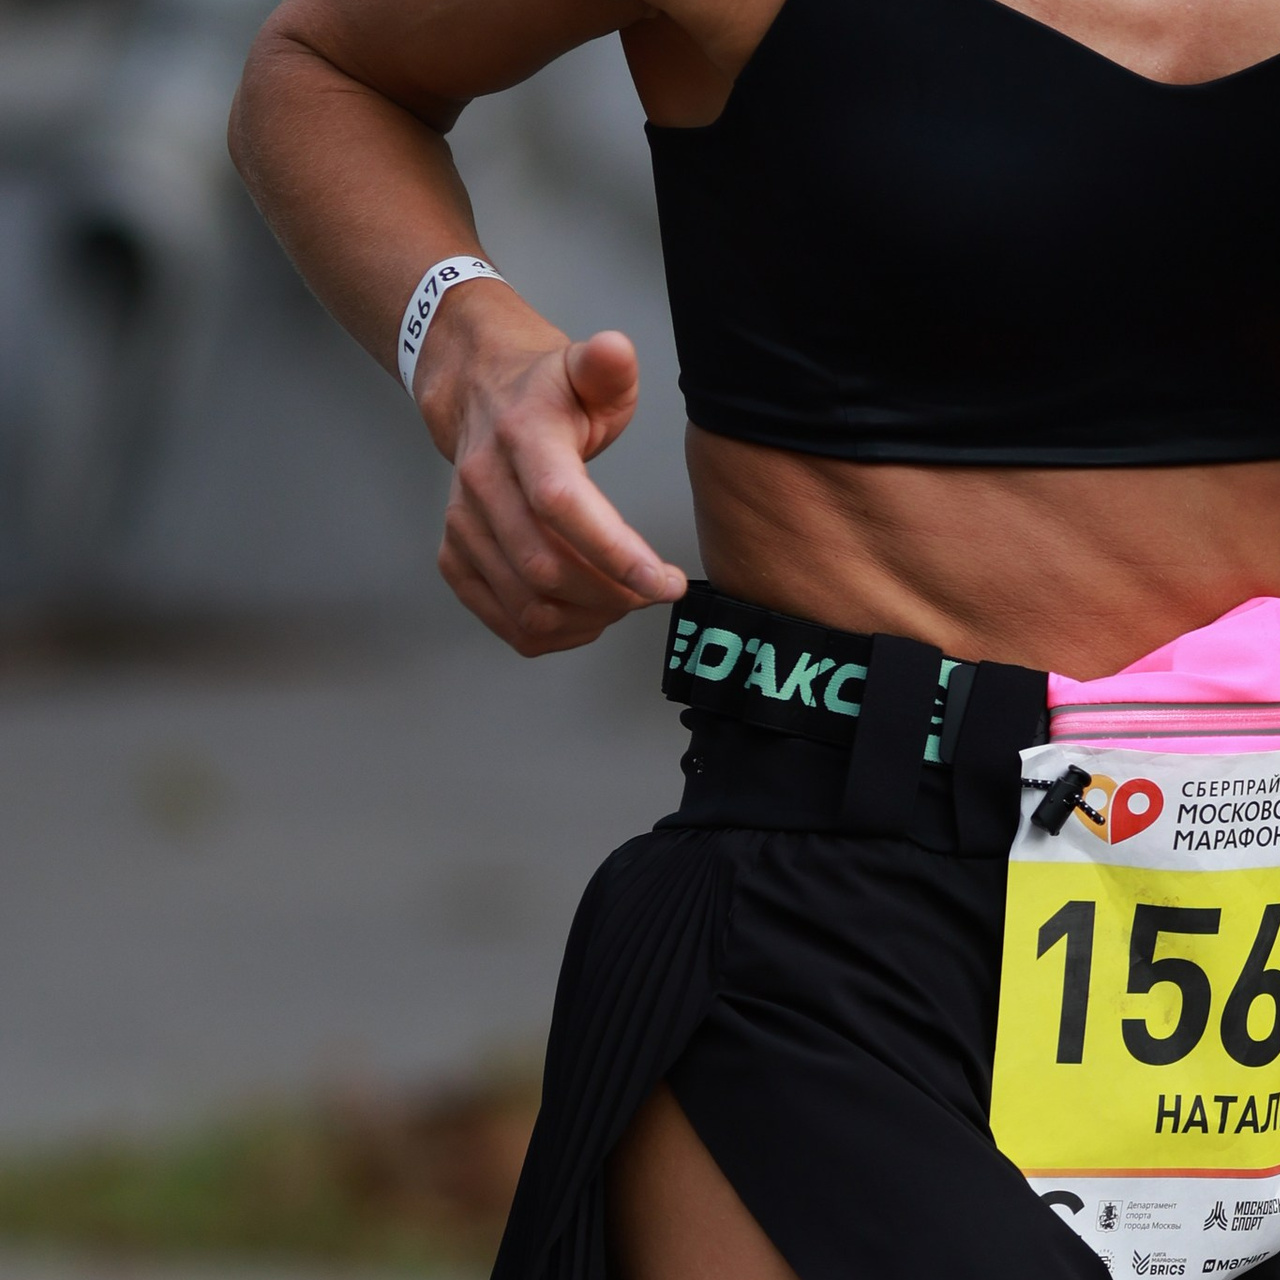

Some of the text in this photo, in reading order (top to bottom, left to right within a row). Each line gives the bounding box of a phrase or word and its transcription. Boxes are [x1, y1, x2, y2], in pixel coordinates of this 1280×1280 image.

[403, 266, 460, 355] 15678
[1126, 1201, 1177, 1210] Департамент
[1125, 1211, 1151, 1221] спорта
[1124, 1221, 1182, 1231] города Москвы
[1231, 1216, 1264, 1231] СПОРТ
[1149, 1264, 1186, 1276] BRICS
